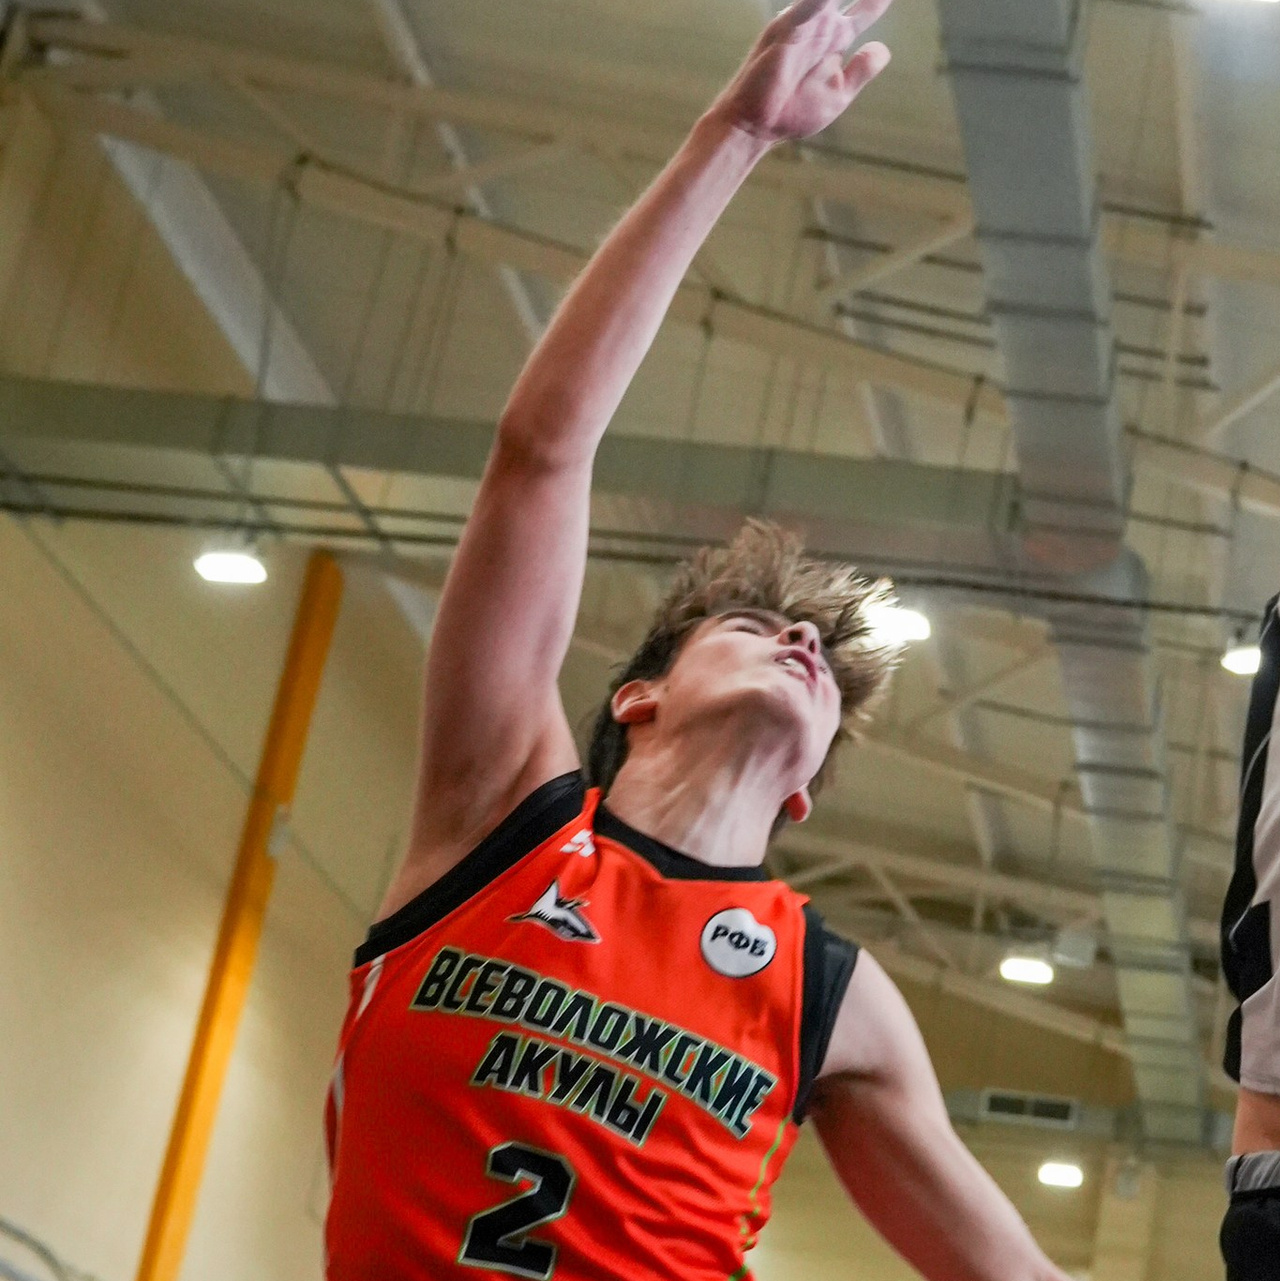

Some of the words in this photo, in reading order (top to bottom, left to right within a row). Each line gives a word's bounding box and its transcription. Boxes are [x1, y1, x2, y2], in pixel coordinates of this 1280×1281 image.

[710, 922, 769, 959] РФБ
[409, 946, 779, 1139] ВСЕВОЛОЖСКИЕ
[470, 1030, 667, 1147] АКУЛЫ
